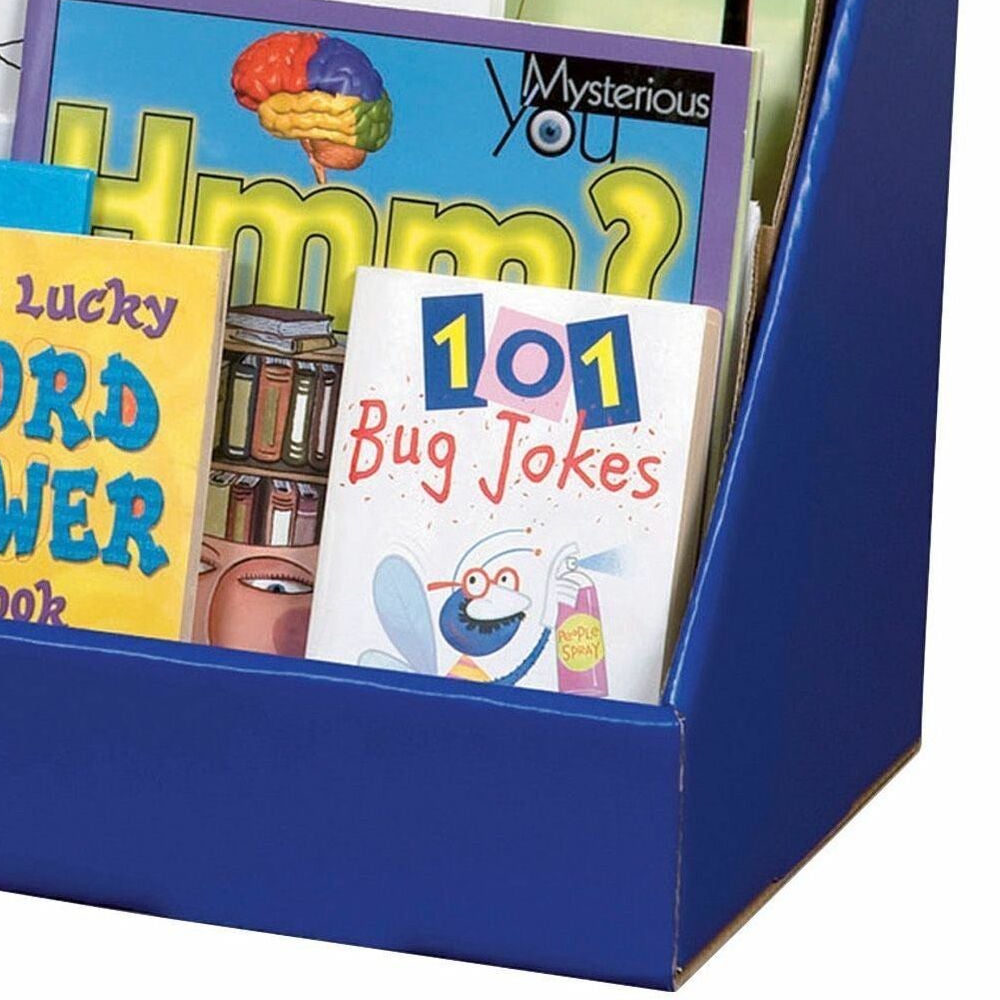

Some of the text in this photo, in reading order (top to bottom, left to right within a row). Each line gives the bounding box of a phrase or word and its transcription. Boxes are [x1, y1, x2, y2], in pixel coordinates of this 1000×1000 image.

[522, 53, 711, 119] Mysterious
[16, 274, 178, 339] Lucky
[432, 313, 621, 408] 101
[349, 399, 662, 504] Bug Jokes
